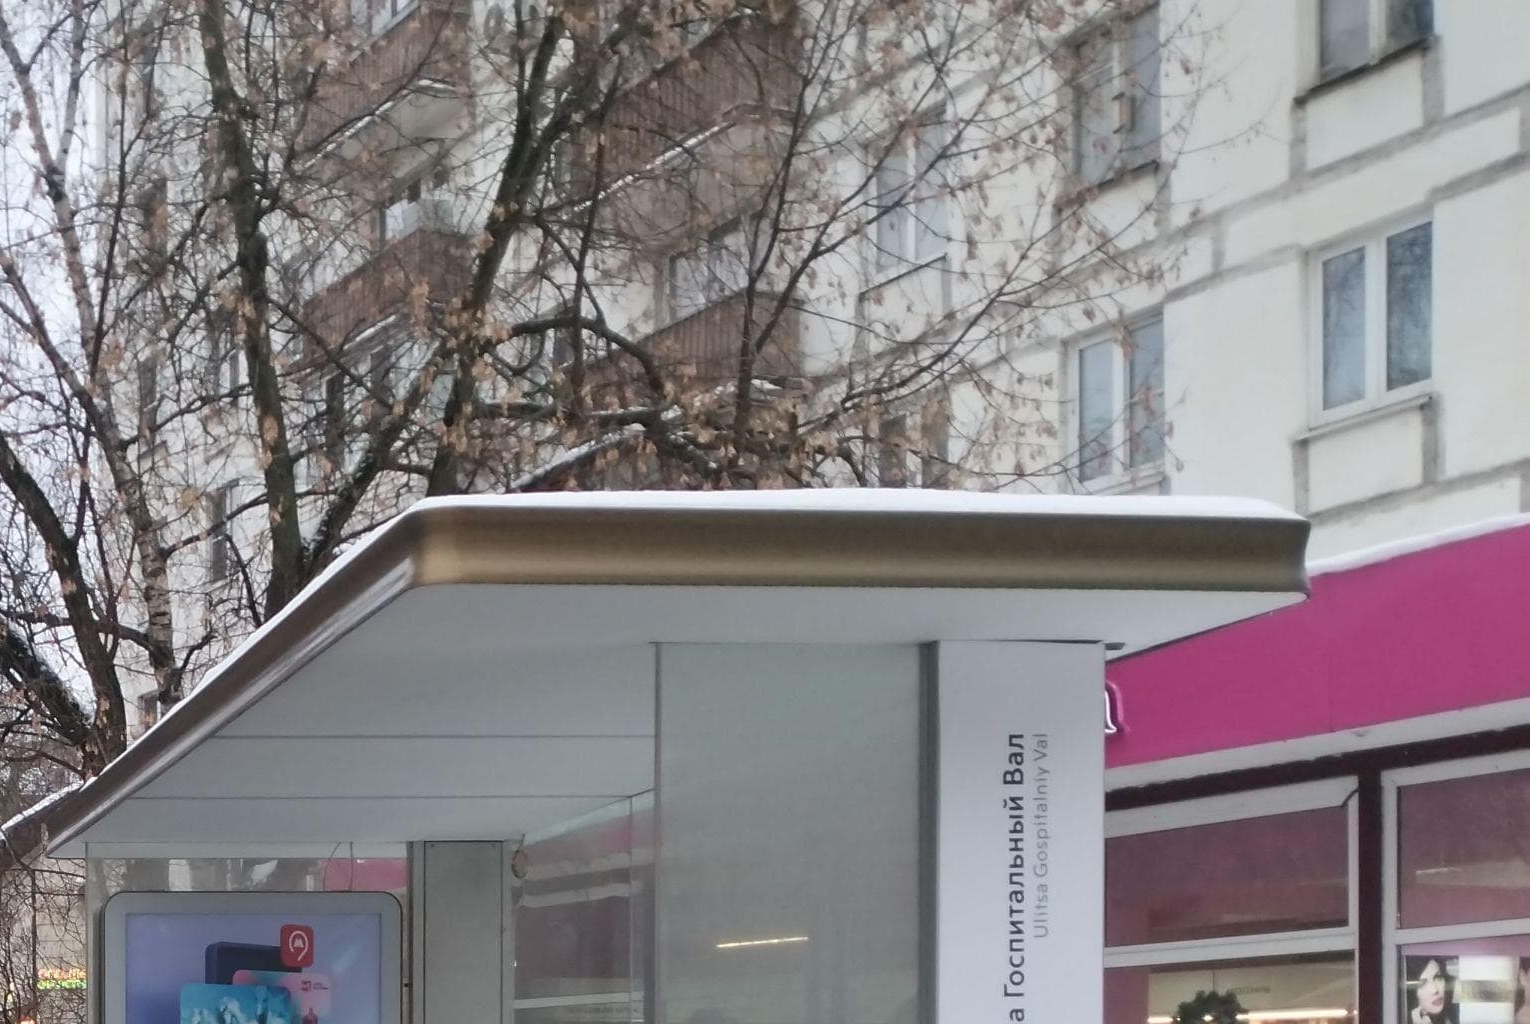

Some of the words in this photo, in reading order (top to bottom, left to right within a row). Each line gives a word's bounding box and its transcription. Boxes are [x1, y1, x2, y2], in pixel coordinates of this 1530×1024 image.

[1002, 733, 1024, 787] Вал
[1032, 734, 1049, 763] Val
[1032, 767, 1051, 878] Gospitalniy
[1002, 795, 1024, 999] Госпитальный
[1033, 882, 1049, 939] Ulitsa
